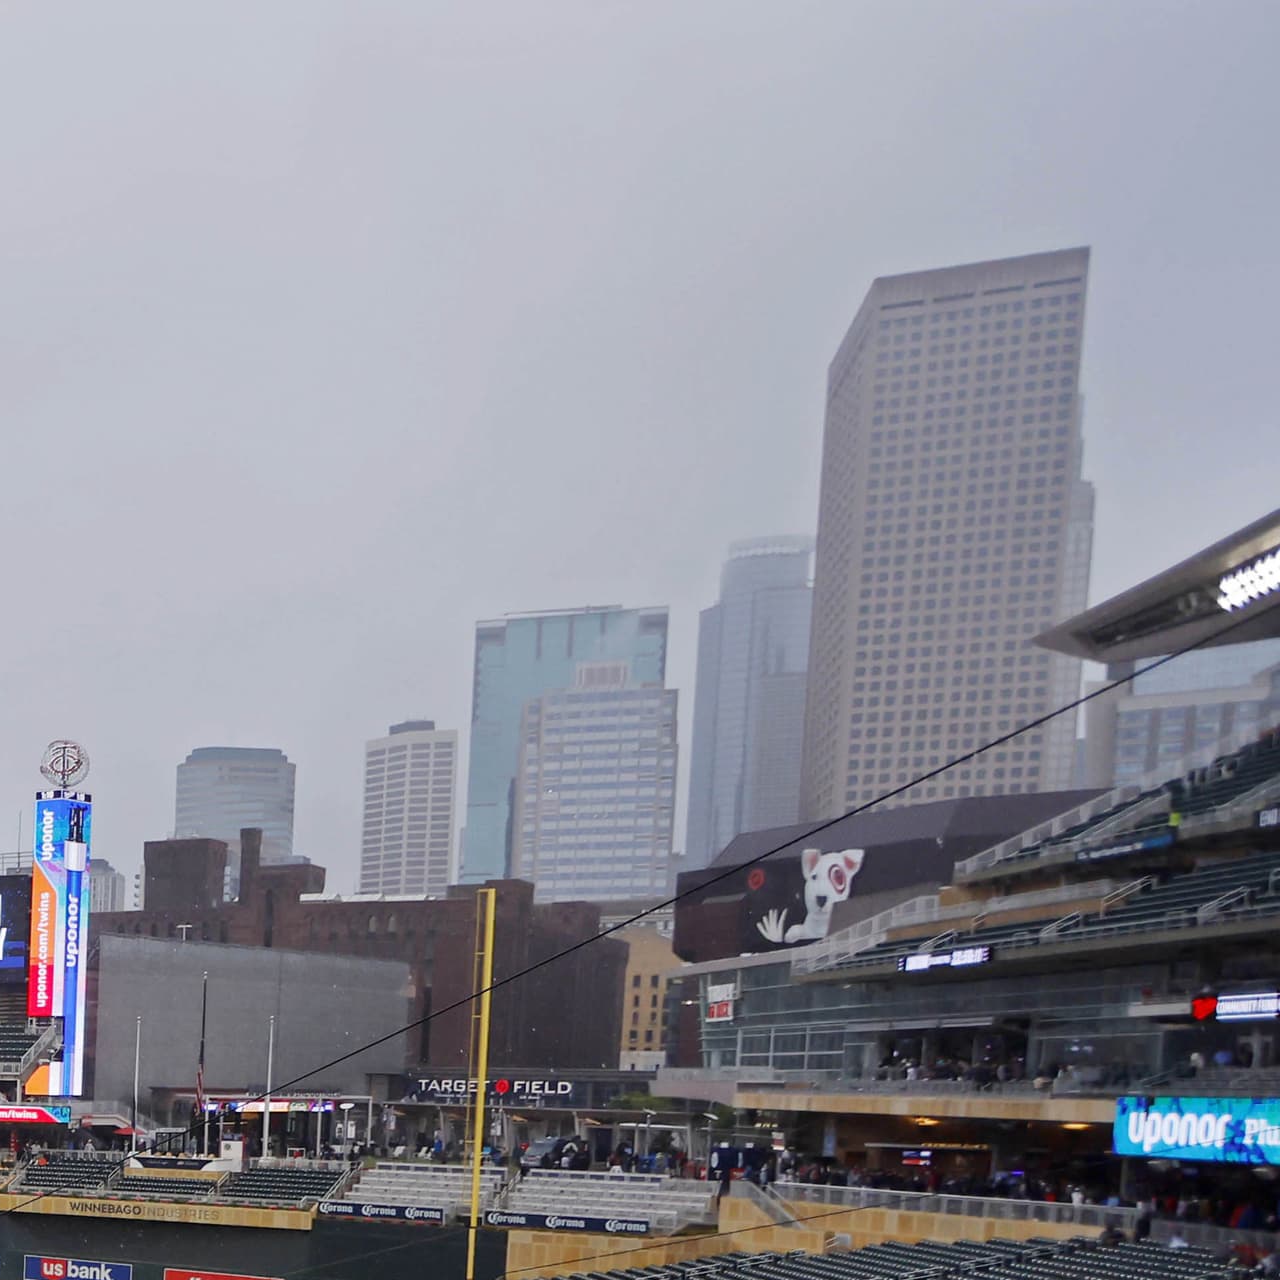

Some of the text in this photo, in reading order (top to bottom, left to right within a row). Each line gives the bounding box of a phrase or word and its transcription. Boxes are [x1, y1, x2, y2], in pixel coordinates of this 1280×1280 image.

[42, 809, 56, 862] uponor
[65, 894, 80, 968] uponor
[36, 891, 51, 1009] uponor.com/twins
[513, 1080, 573, 1094] FIELD
[1127, 1111, 1232, 1153] uponor
[69, 1201, 220, 1222] WINNEBAGO INDUSTRIES
[319, 1201, 354, 1215] Corona
[361, 1204, 397, 1217] Corona
[404, 1206, 441, 1220] Corona
[487, 1211, 527, 1225] Corona
[545, 1215, 585, 1229] Corona
[605, 1218, 647, 1233] Corona
[42, 1262, 64, 1277] us
